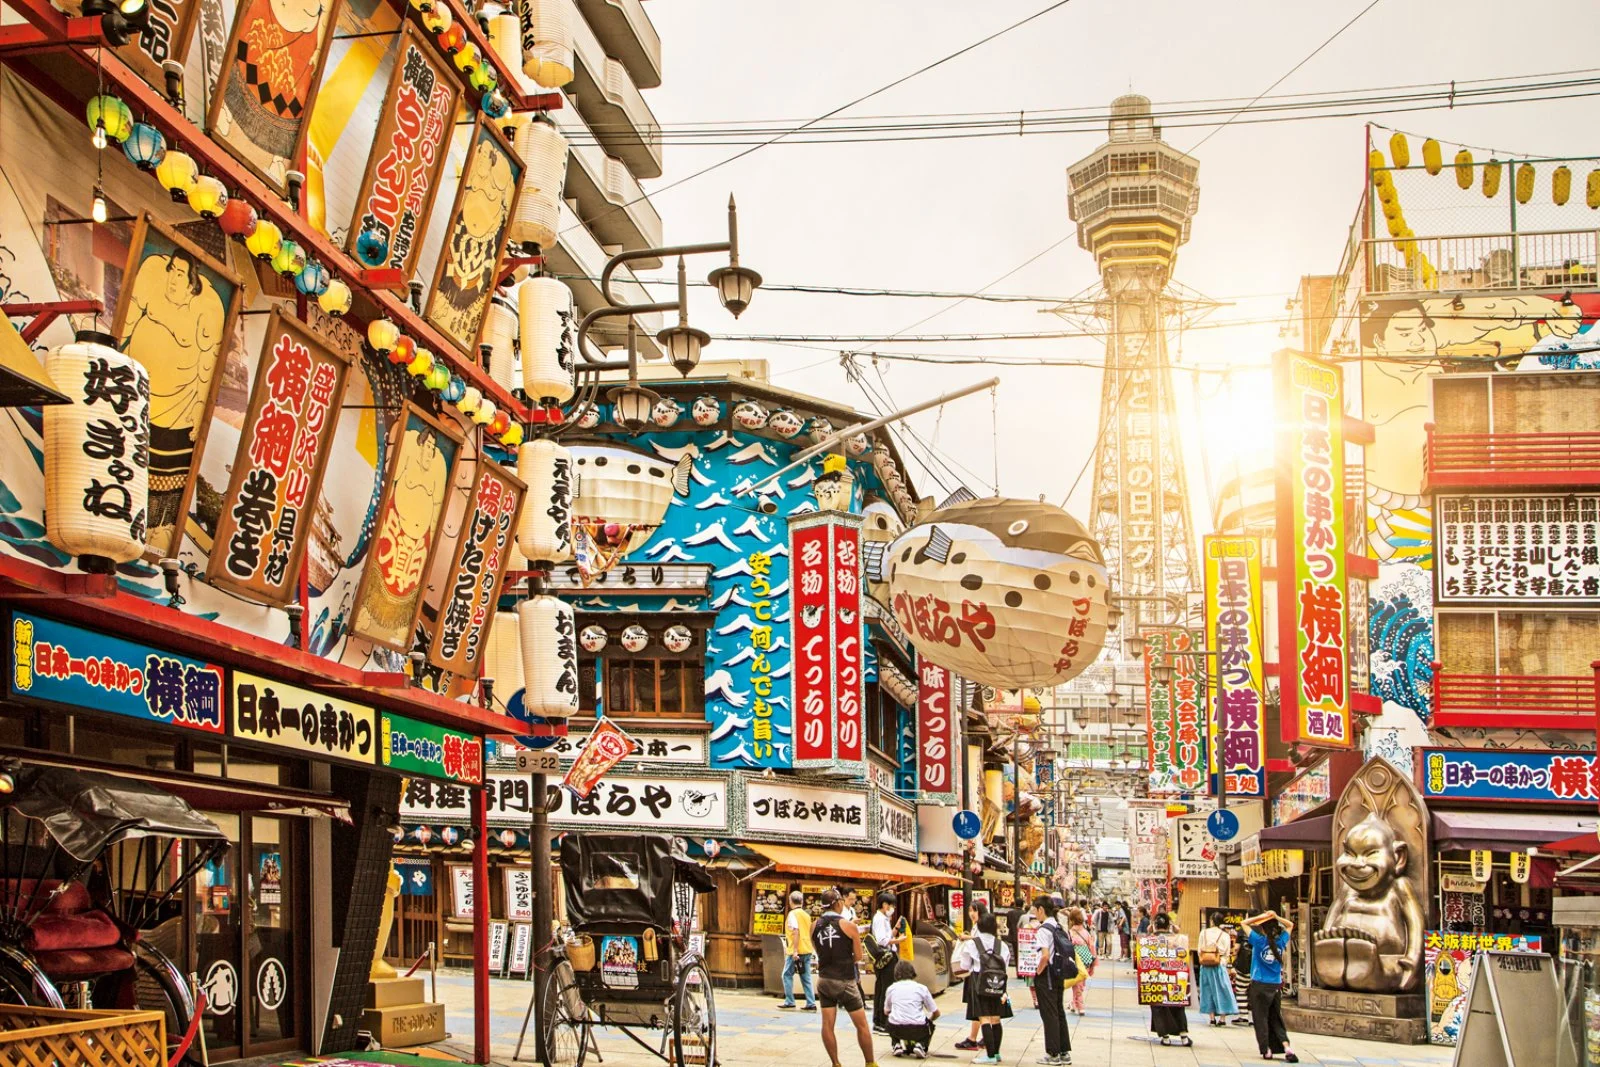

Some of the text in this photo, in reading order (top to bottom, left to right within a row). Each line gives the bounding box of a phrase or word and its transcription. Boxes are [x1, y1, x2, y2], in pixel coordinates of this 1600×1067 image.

[226, 334, 312, 578] 横綱巻き
[264, 362, 336, 586] 盛り沢山具材
[441, 472, 504, 661] 揚げたこ焼き
[1299, 394, 1344, 708] 日本一の串かつ 横綱
[1445, 547, 1460, 595] もち
[1462, 547, 1478, 595] うずら玉子
[1478, 547, 1495, 595] 紅しょうが
[1495, 547, 1511, 595] にんにく
[1512, 547, 1529, 595] 玉ねぎ
[1529, 547, 1546, 595] 山芋
[1547, 547, 1564, 595] しし唐
[1564, 547, 1582, 595] れんこん
[1581, 547, 1599, 595] 銀杏
[800, 539, 824, 748] 名物 てっちり
[837, 539, 858, 749] 名物 てっちり
[893, 590, 996, 653] づぼらや
[1053, 597, 1092, 674] づぼらや
[14, 618, 35, 690] 新世界
[749, 551, 772, 759] 安うて何んでも旨い
[1214, 560, 1259, 771] 日本一の串かつ 横綱
[34, 644, 222, 727] 日本一の串かつ 横綱
[236, 682, 372, 757] 日本一の串かつ
[921, 652, 948, 787] 味てっちり
[1307, 710, 1343, 739] 酒処
[391, 731, 481, 782] 日本一の串かつ 横綱
[1429, 754, 1444, 792] 新世界
[1446, 757, 1598, 799] 日本一の串かつ 横
[752, 797, 862, 826] づぼらや本店
[1427, 933, 1513, 951] 大阪新世界
[1308, 992, 1383, 1014] BILLIKEN
